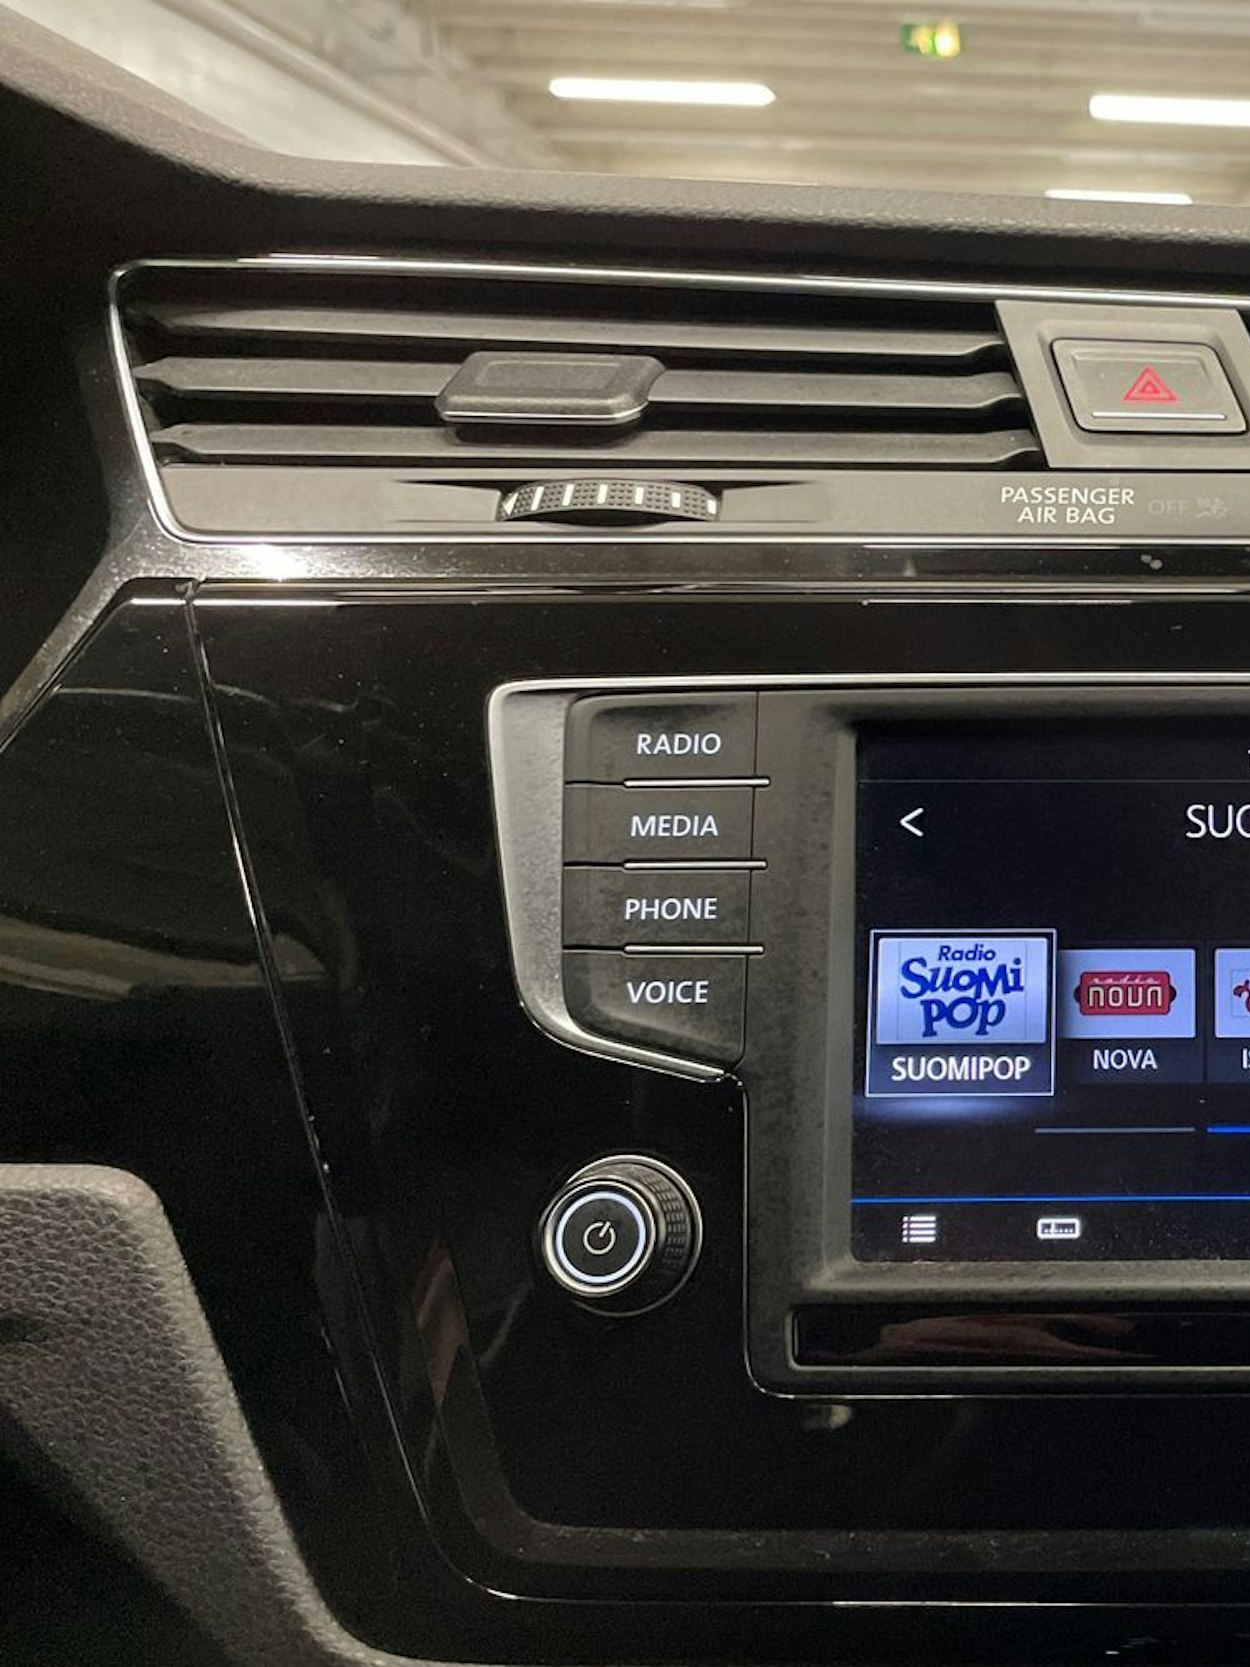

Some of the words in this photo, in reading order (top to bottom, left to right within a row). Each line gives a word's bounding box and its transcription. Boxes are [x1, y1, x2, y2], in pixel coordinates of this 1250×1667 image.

[1000, 486, 1136, 506] PASSENGER
[1147, 498, 1188, 517] OFF
[1017, 506, 1058, 524] AIR
[1065, 506, 1116, 525] BAG
[635, 732, 723, 756] RADIO
[630, 814, 720, 838] MEDIA
[623, 897, 719, 922] PHONE
[937, 944, 997, 962] Radio
[627, 980, 710, 1004] VOICE
[890, 1055, 1032, 1082] SUOMIPOP
[1092, 1048, 1158, 1071] NOVA
